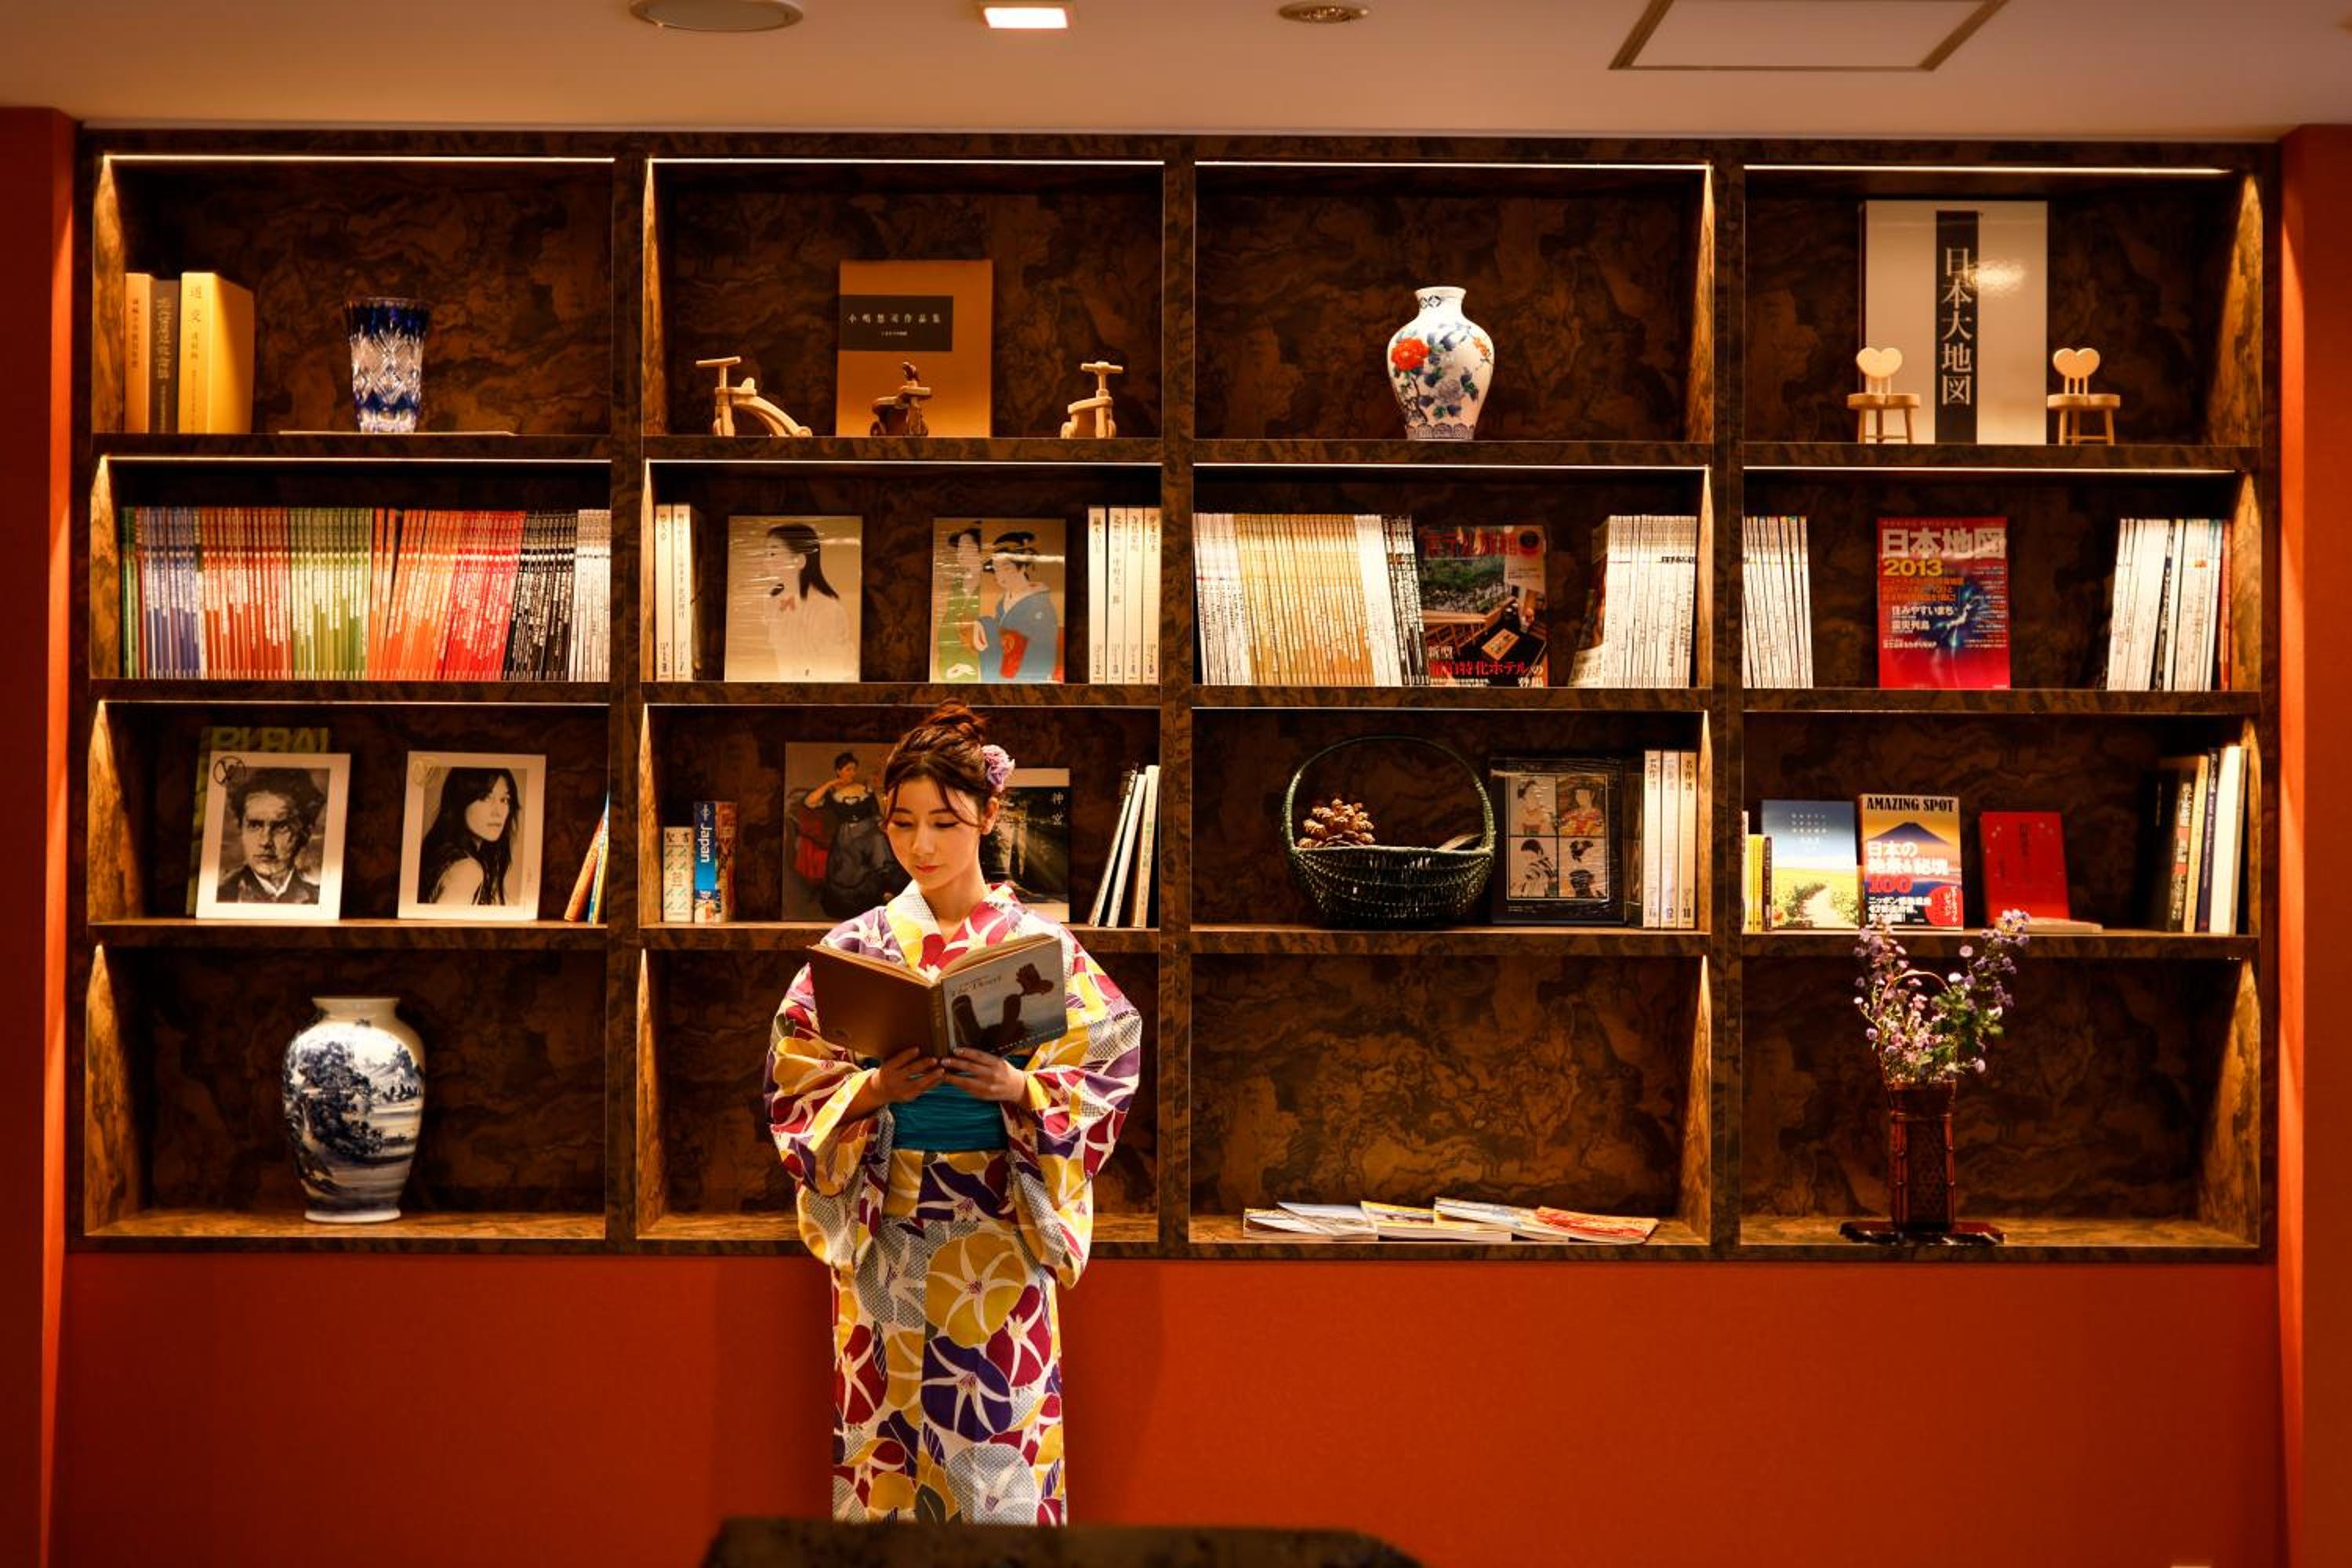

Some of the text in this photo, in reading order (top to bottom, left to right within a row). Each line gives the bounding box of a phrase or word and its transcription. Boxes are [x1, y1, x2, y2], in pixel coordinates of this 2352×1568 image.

[1941, 248, 1973, 405] 日本大地図
[1882, 527, 2006, 559] 日本地図
[1883, 559, 1944, 577] 2013
[1867, 797, 1955, 812] AMAZING SPOT
[698, 824, 713, 863] Japan
[1867, 840, 1918, 858] 日本の
[1868, 874, 1913, 893] 100
